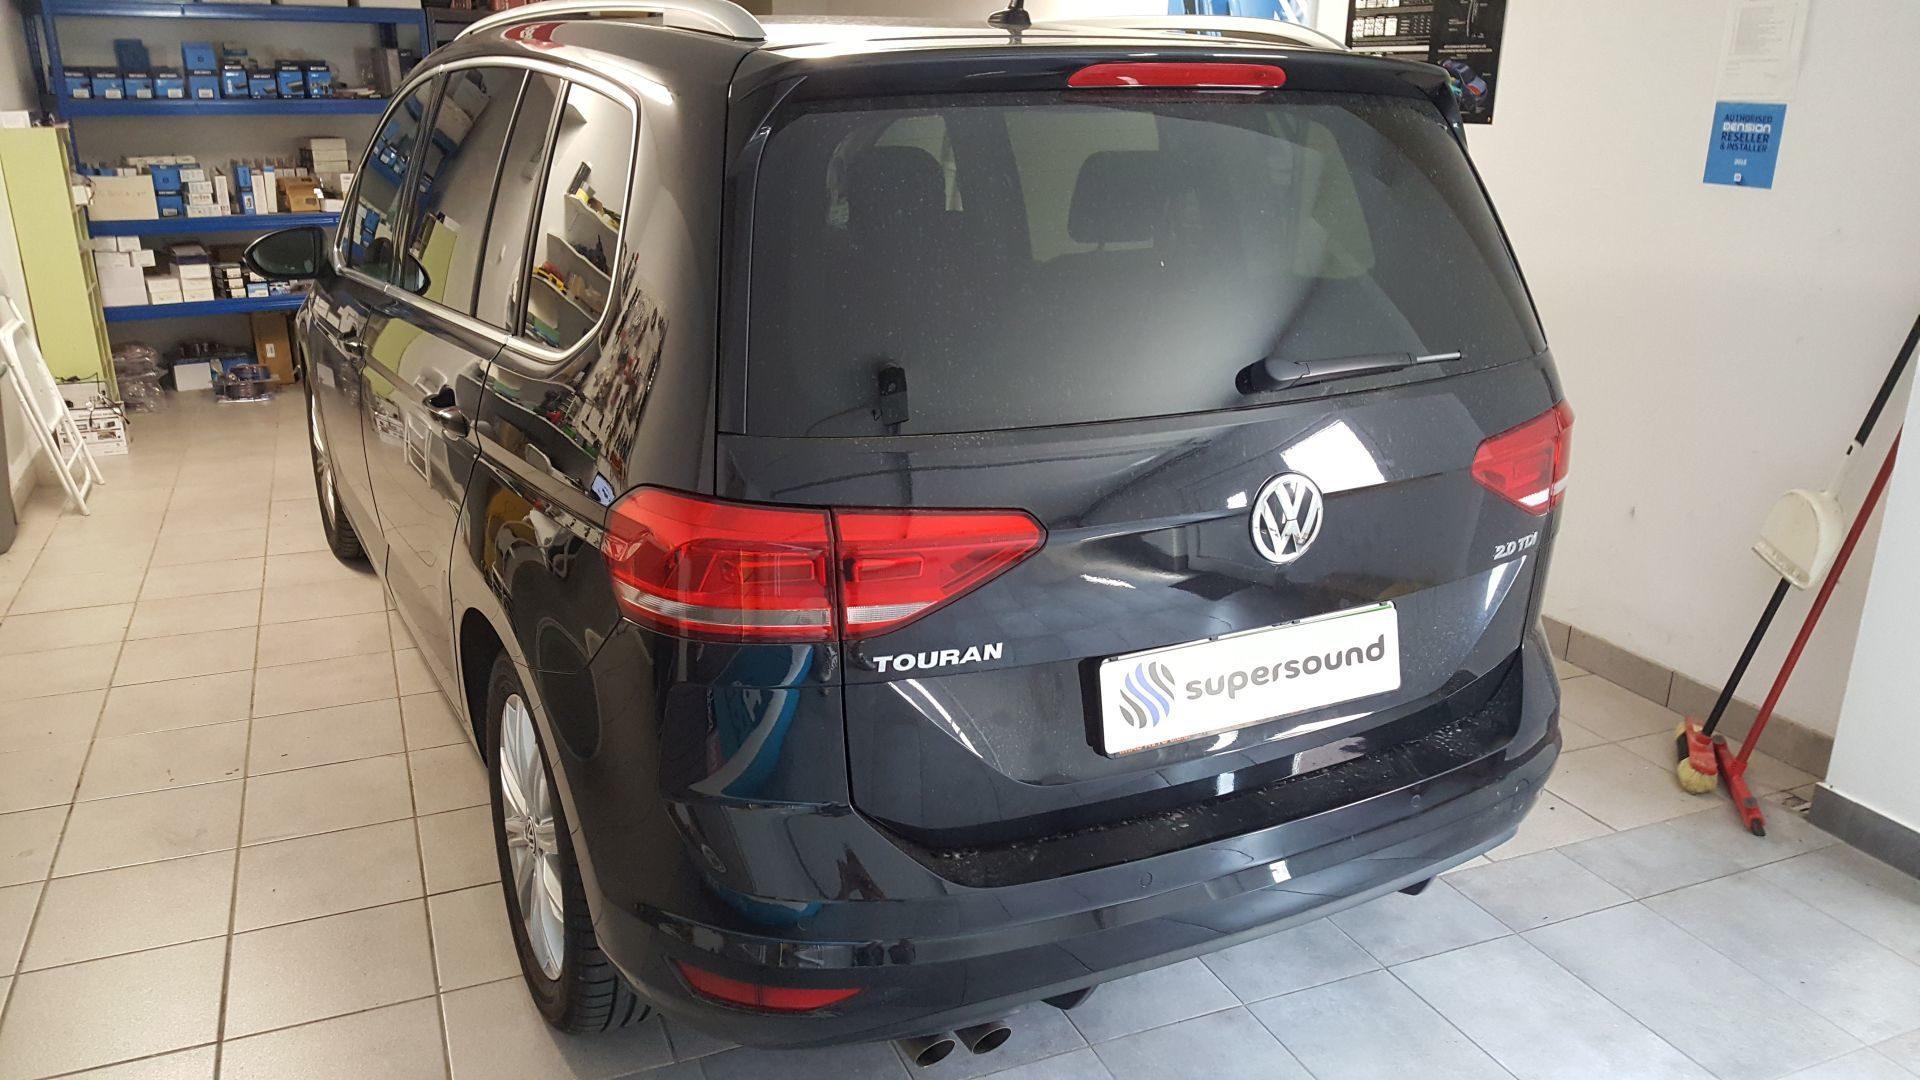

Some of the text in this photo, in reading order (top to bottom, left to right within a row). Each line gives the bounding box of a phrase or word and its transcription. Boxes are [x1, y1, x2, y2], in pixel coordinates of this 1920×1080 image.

[1720, 131, 1770, 144] RESELLER
[1726, 142, 1768, 152] INSTALLER
[1249, 471, 1324, 565] VW
[1517, 531, 1538, 552] TDI
[872, 642, 1003, 673] TOURAN
[1186, 633, 1385, 700] supersound
